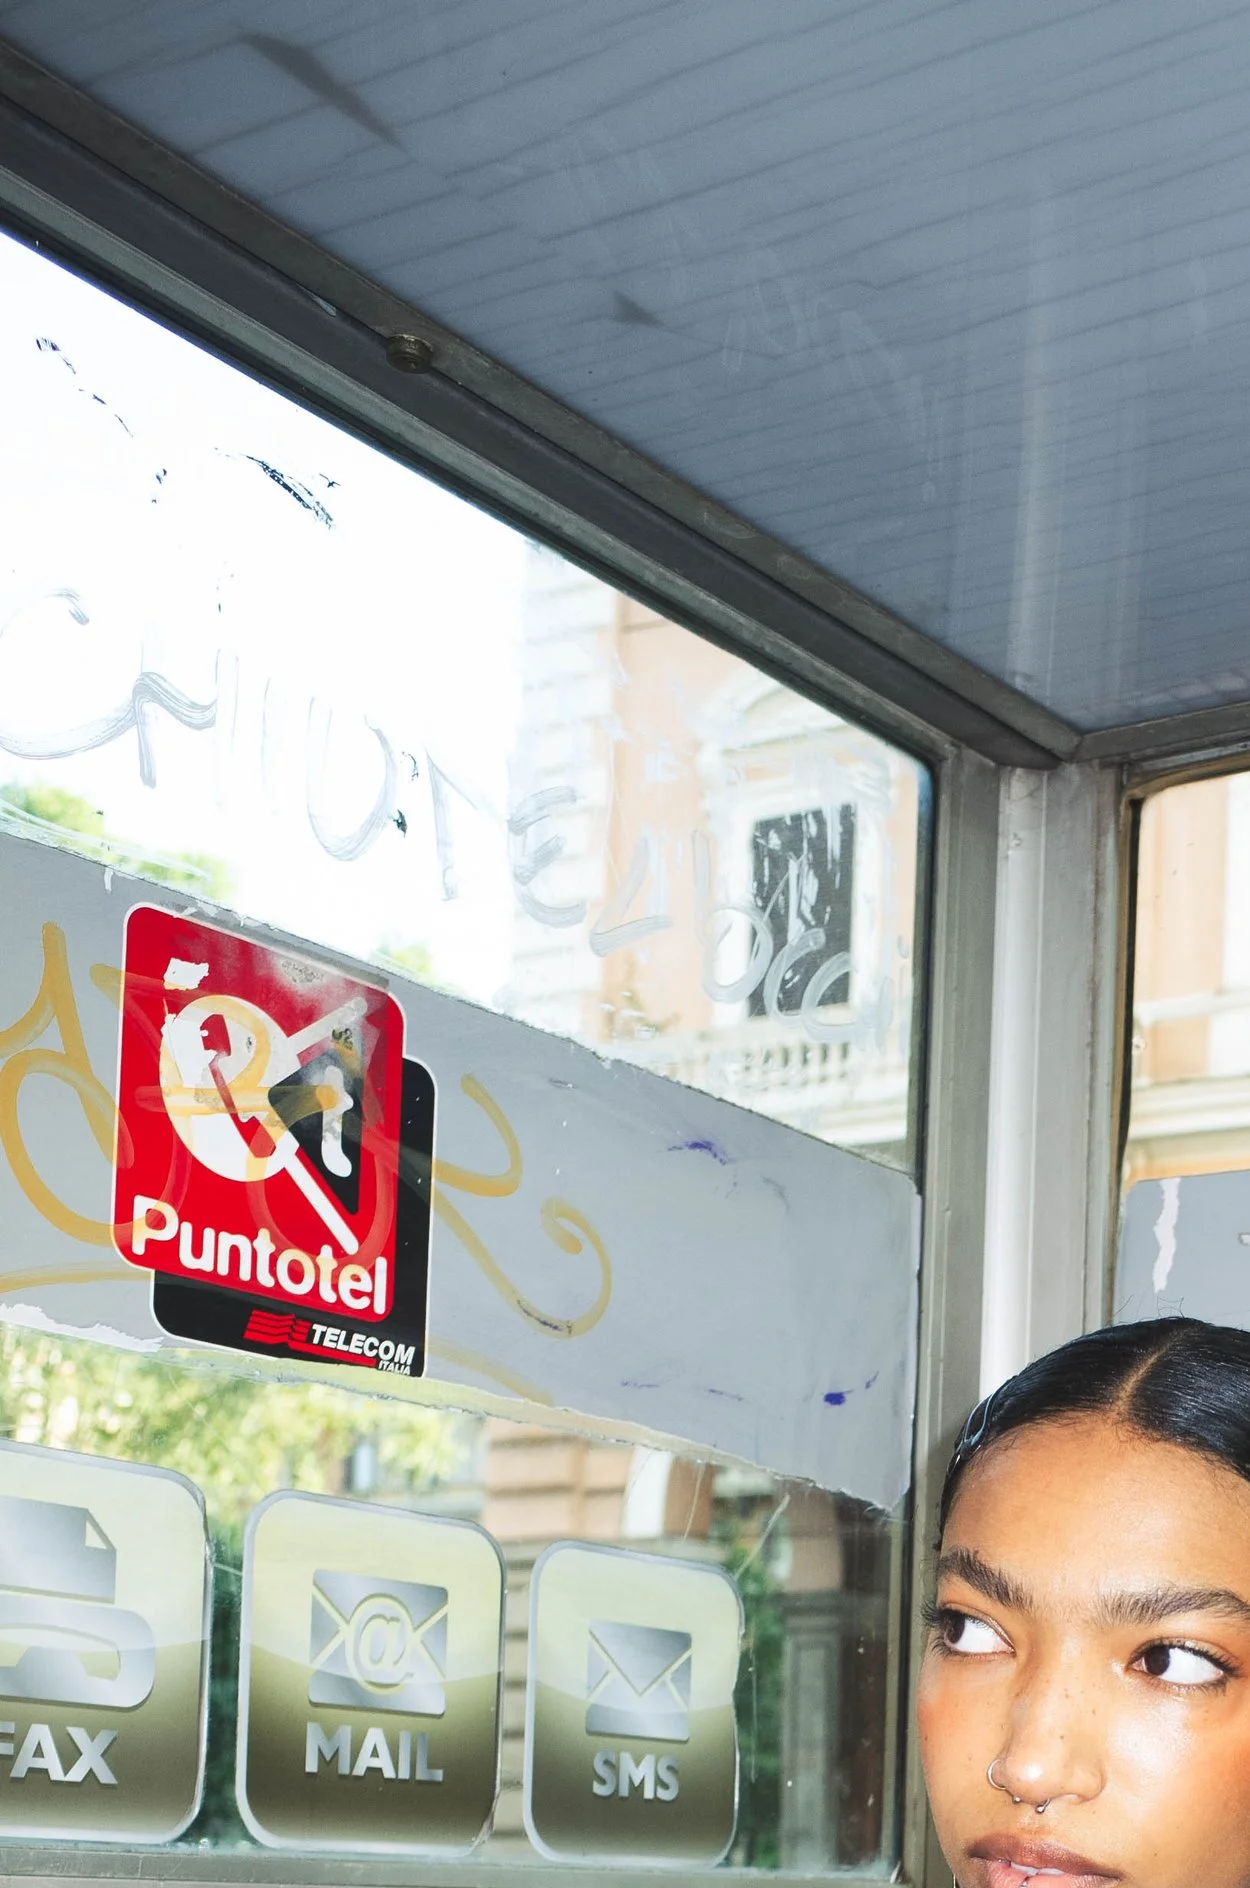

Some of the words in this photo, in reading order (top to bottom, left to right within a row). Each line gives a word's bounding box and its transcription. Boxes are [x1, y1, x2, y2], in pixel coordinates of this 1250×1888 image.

[132, 1194, 388, 1315] Puntotel
[312, 1324, 415, 1364] TELECOM
[305, 1722, 444, 1783] MAIL
[592, 1749, 680, 1802] SMS
